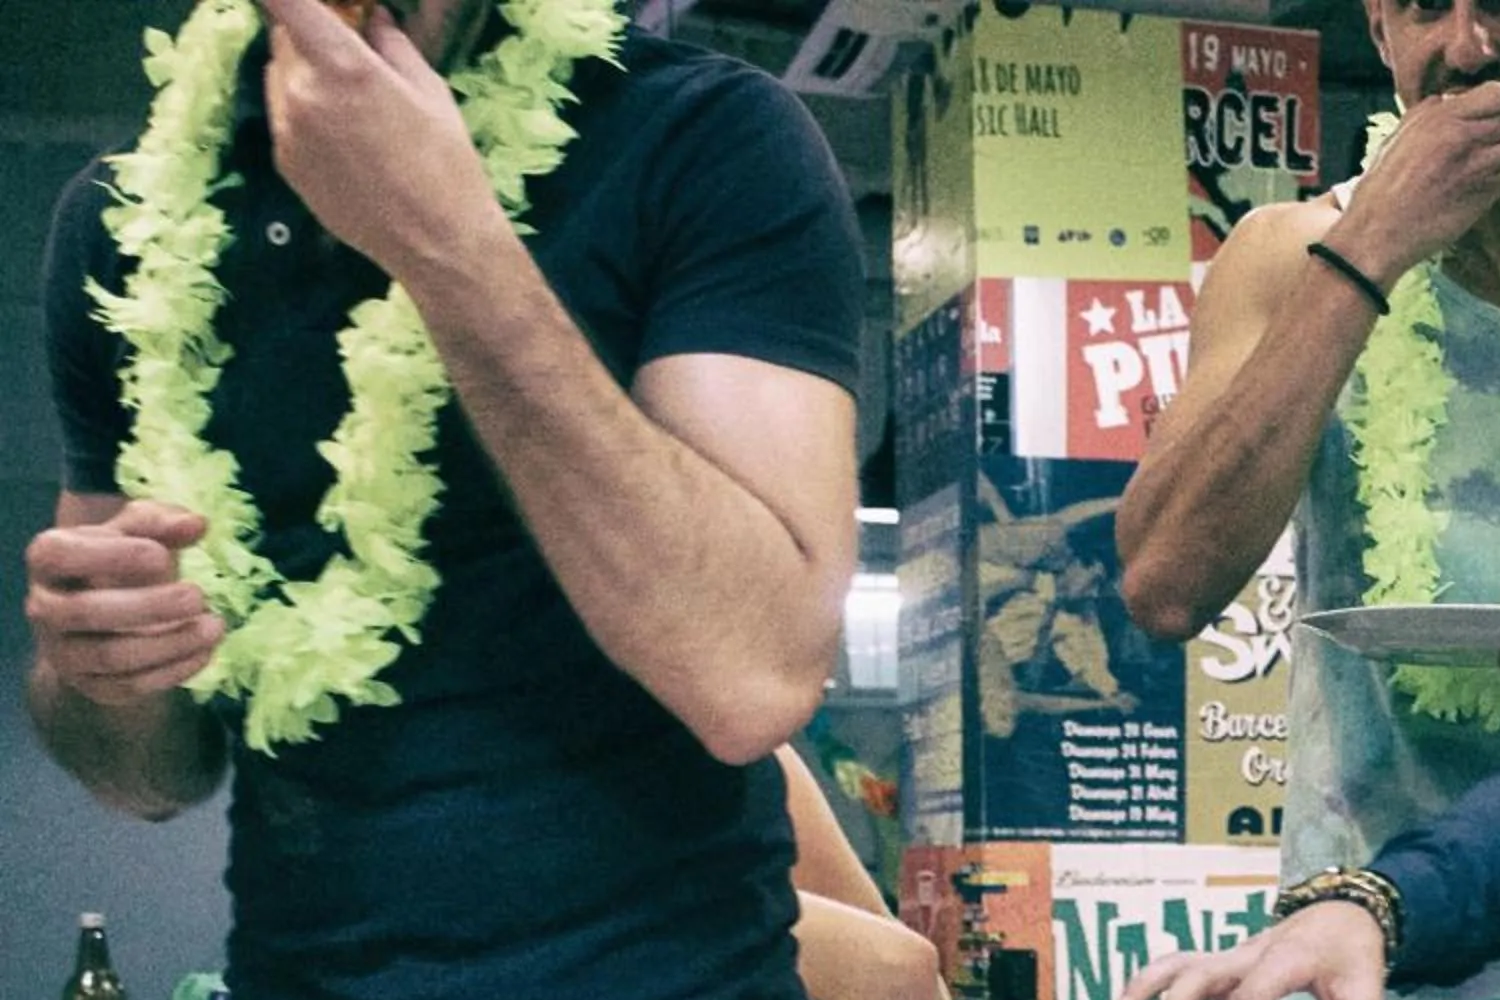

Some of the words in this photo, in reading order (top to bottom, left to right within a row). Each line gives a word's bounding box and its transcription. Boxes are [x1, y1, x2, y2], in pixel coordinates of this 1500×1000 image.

[1189, 31, 1220, 73] 19
[1230, 44, 1287, 79] MAYO
[995, 62, 1017, 95] DE
[1025, 63, 1082, 97] MAYO
[1124, 285, 1191, 333] LA
